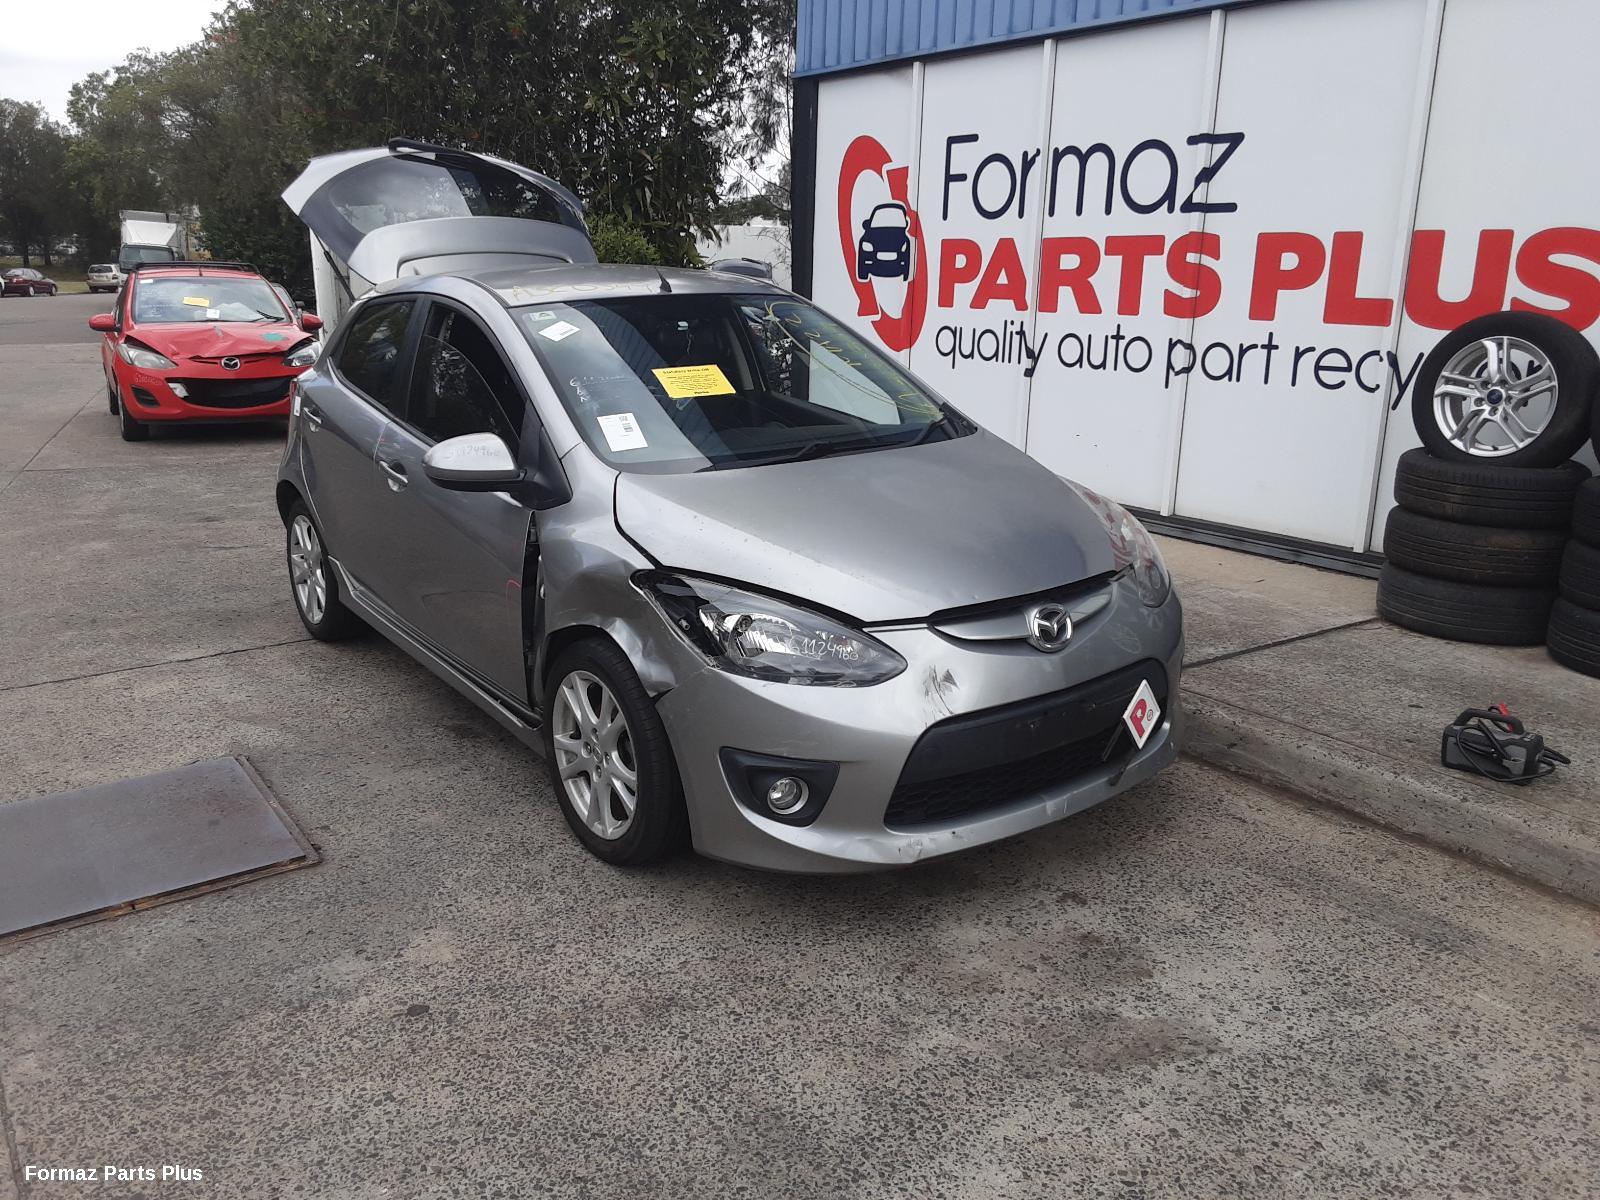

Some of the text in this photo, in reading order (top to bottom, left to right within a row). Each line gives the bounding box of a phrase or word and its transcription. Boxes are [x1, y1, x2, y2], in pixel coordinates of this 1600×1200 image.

[943, 130, 1244, 220] Formaz
[939, 227, 1600, 331] PARTS PLUS
[936, 320, 1048, 378] quality
[1058, 323, 1152, 373] auto
[1165, 332, 1280, 389] part
[1130, 698, 1147, 739] P
